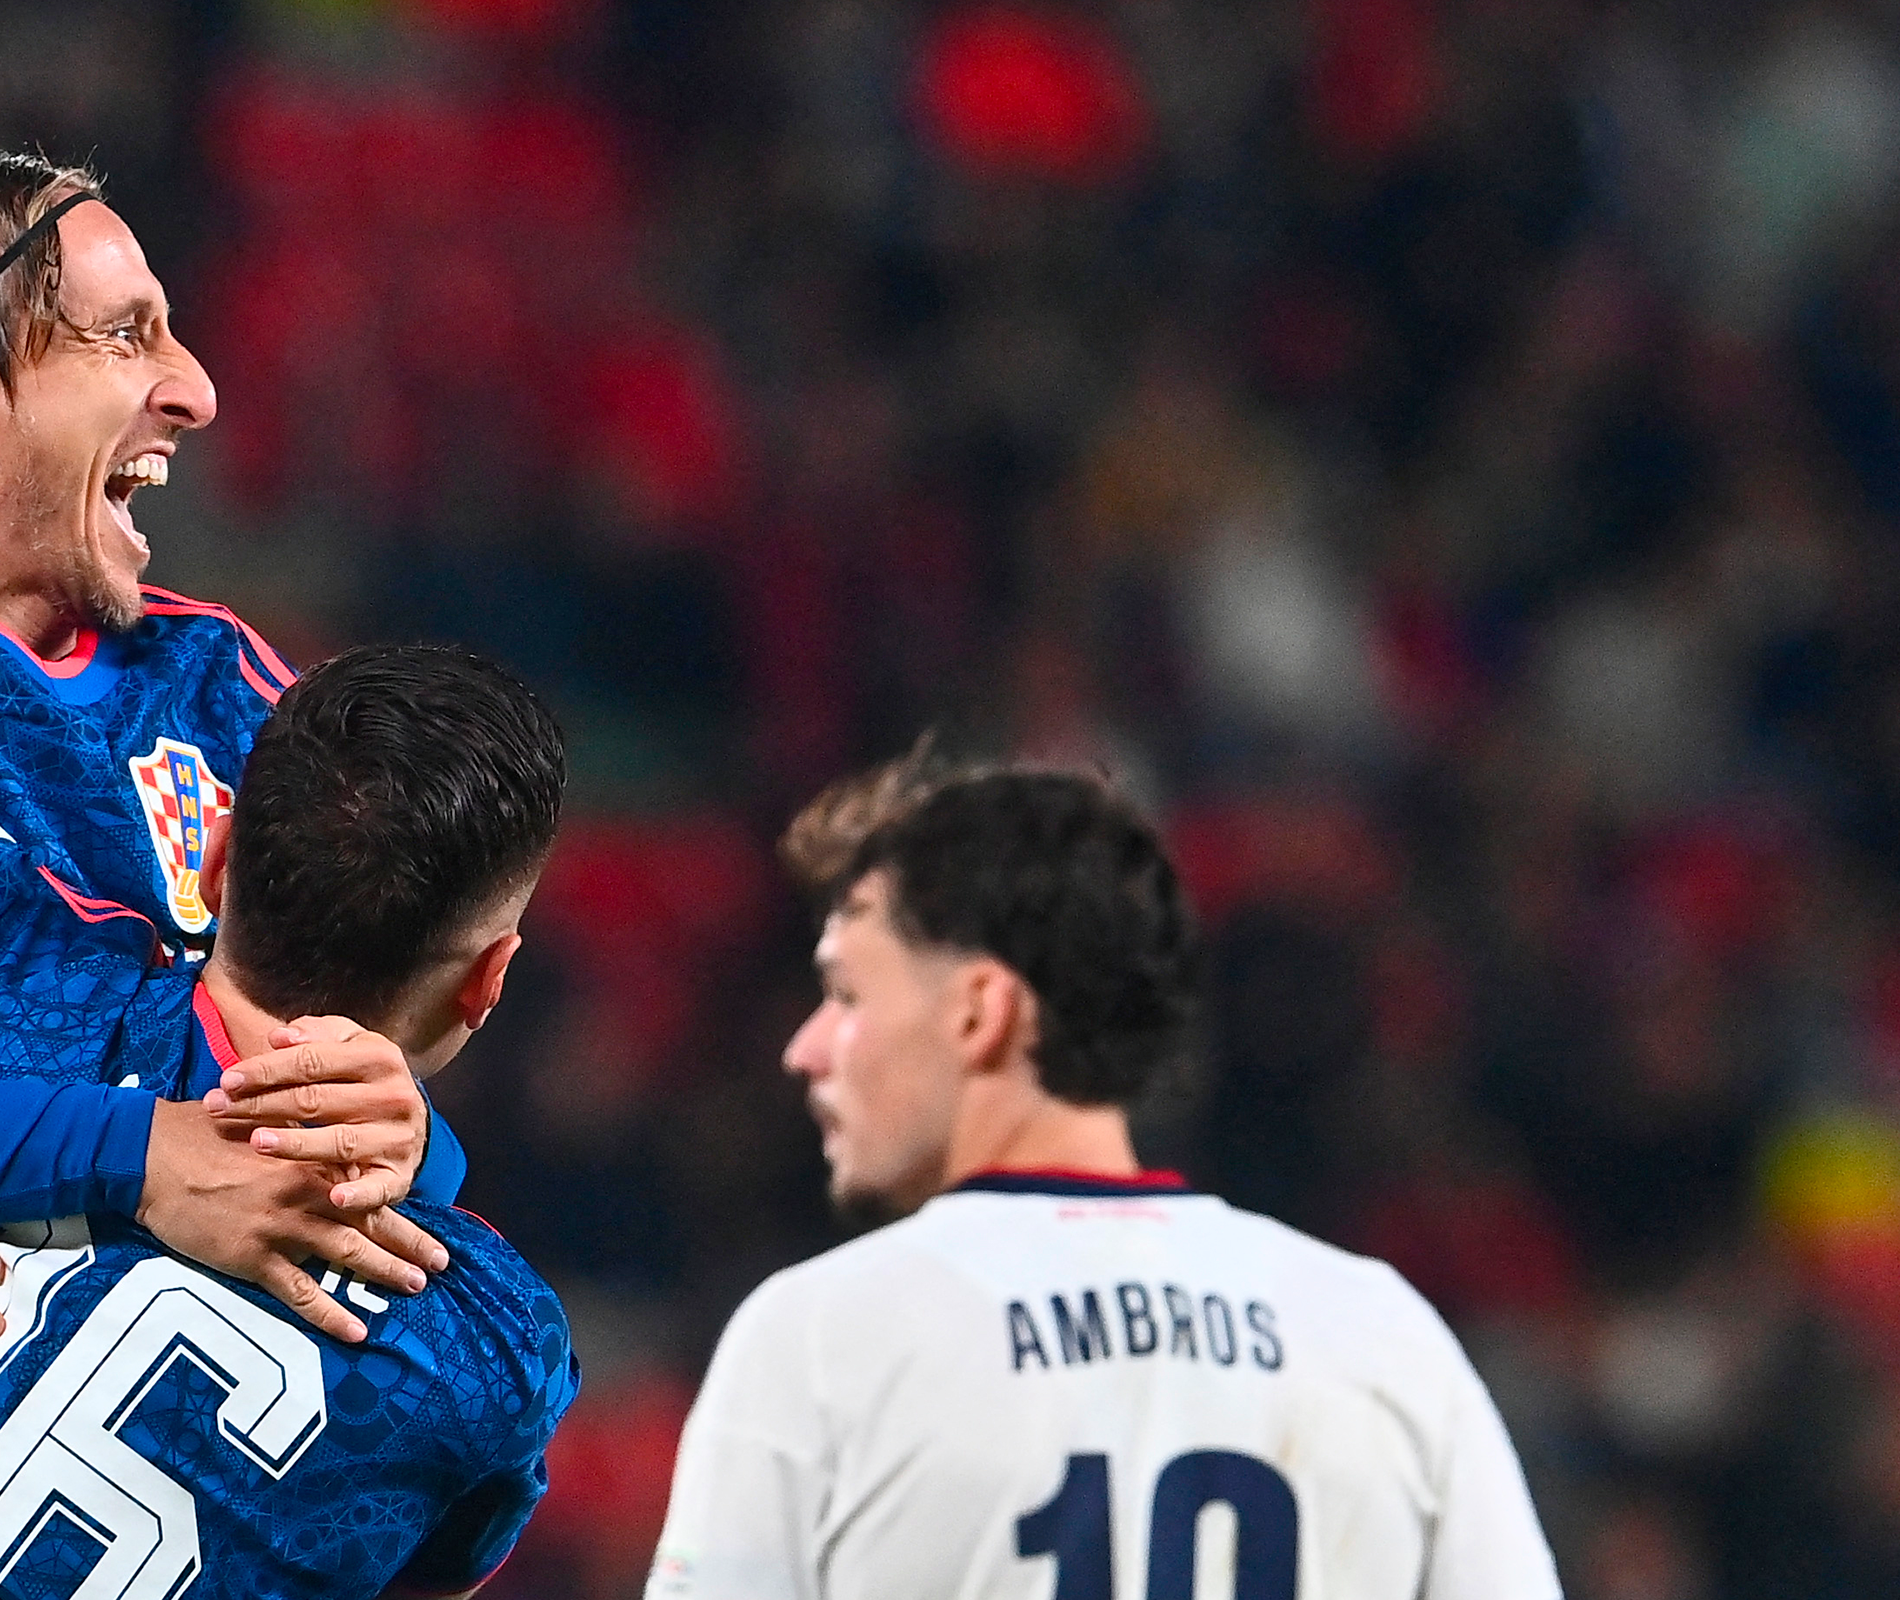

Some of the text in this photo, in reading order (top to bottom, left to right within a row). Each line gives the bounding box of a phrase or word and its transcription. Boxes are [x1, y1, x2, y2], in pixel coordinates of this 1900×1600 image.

[176, 763, 199, 851] HNS
[1006, 1281, 1284, 1371] AMBROS
[1017, 1449, 1299, 1600] 10
